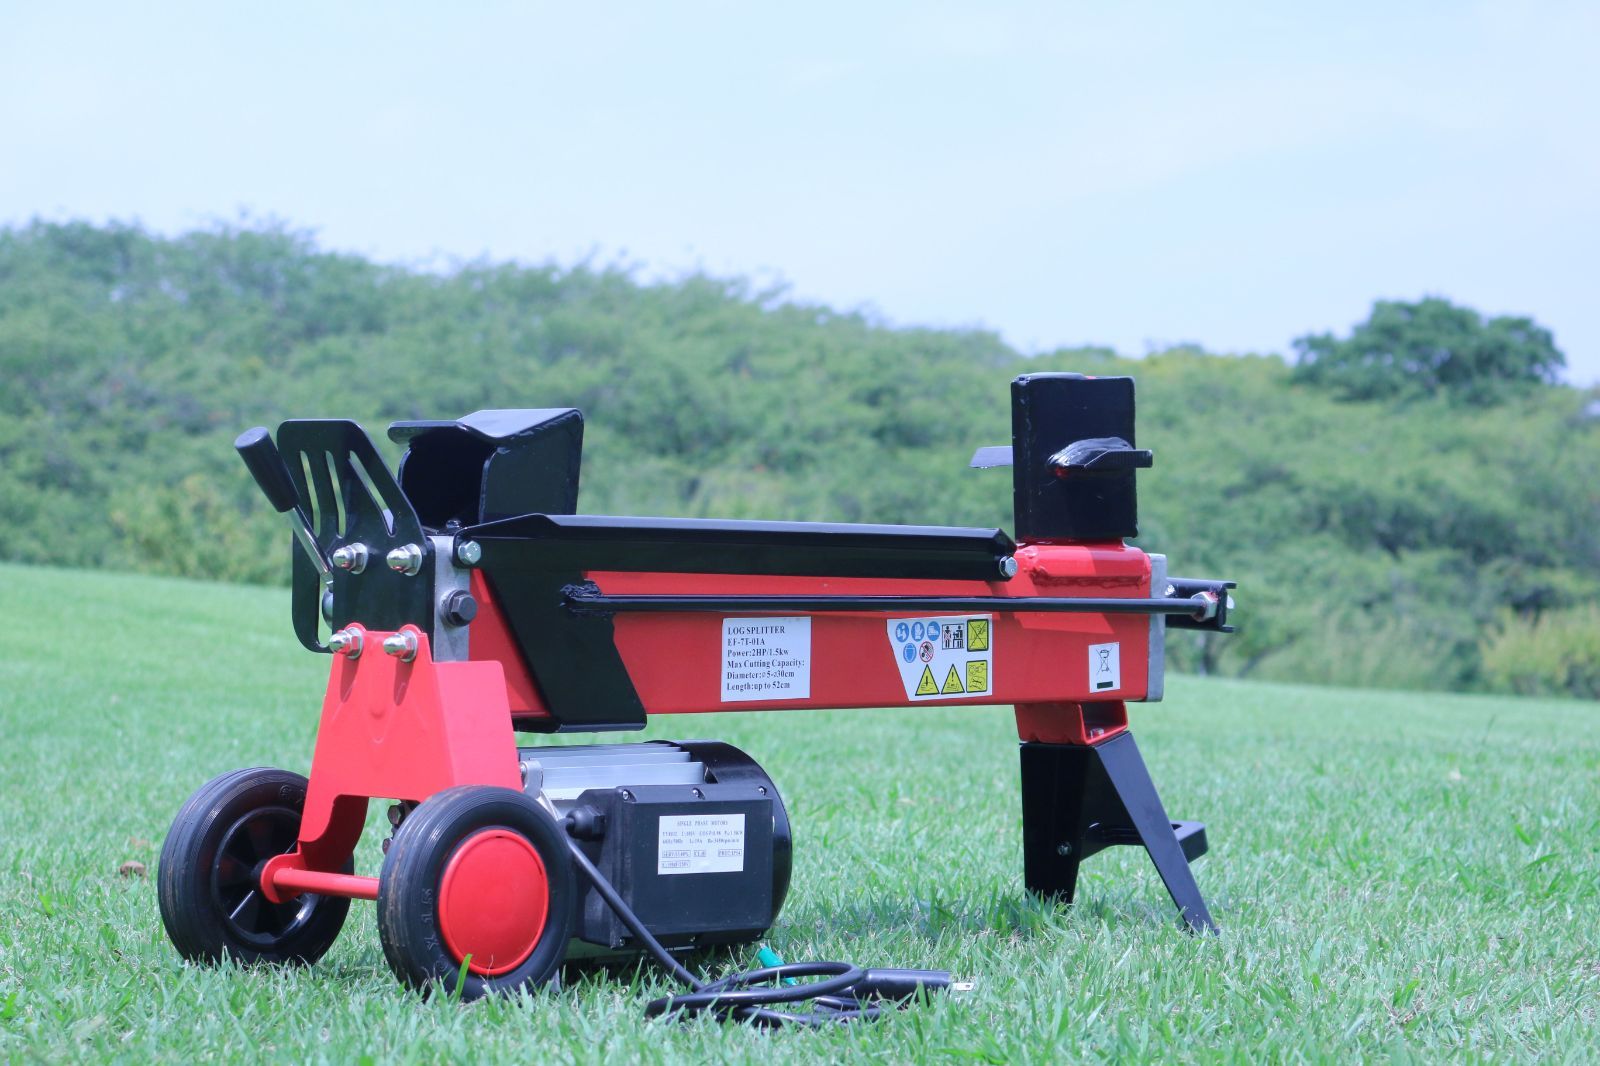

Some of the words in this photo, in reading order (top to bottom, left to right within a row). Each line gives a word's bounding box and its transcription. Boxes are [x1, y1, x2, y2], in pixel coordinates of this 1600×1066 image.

[728, 626, 745, 635] LOG
[746, 626, 785, 635] SPLITTER
[727, 660, 742, 669] Max
[743, 660, 771, 669] Cutting
[771, 658, 805, 669] Capacity:
[764, 682, 771, 690] to
[772, 680, 791, 690] 52cm
